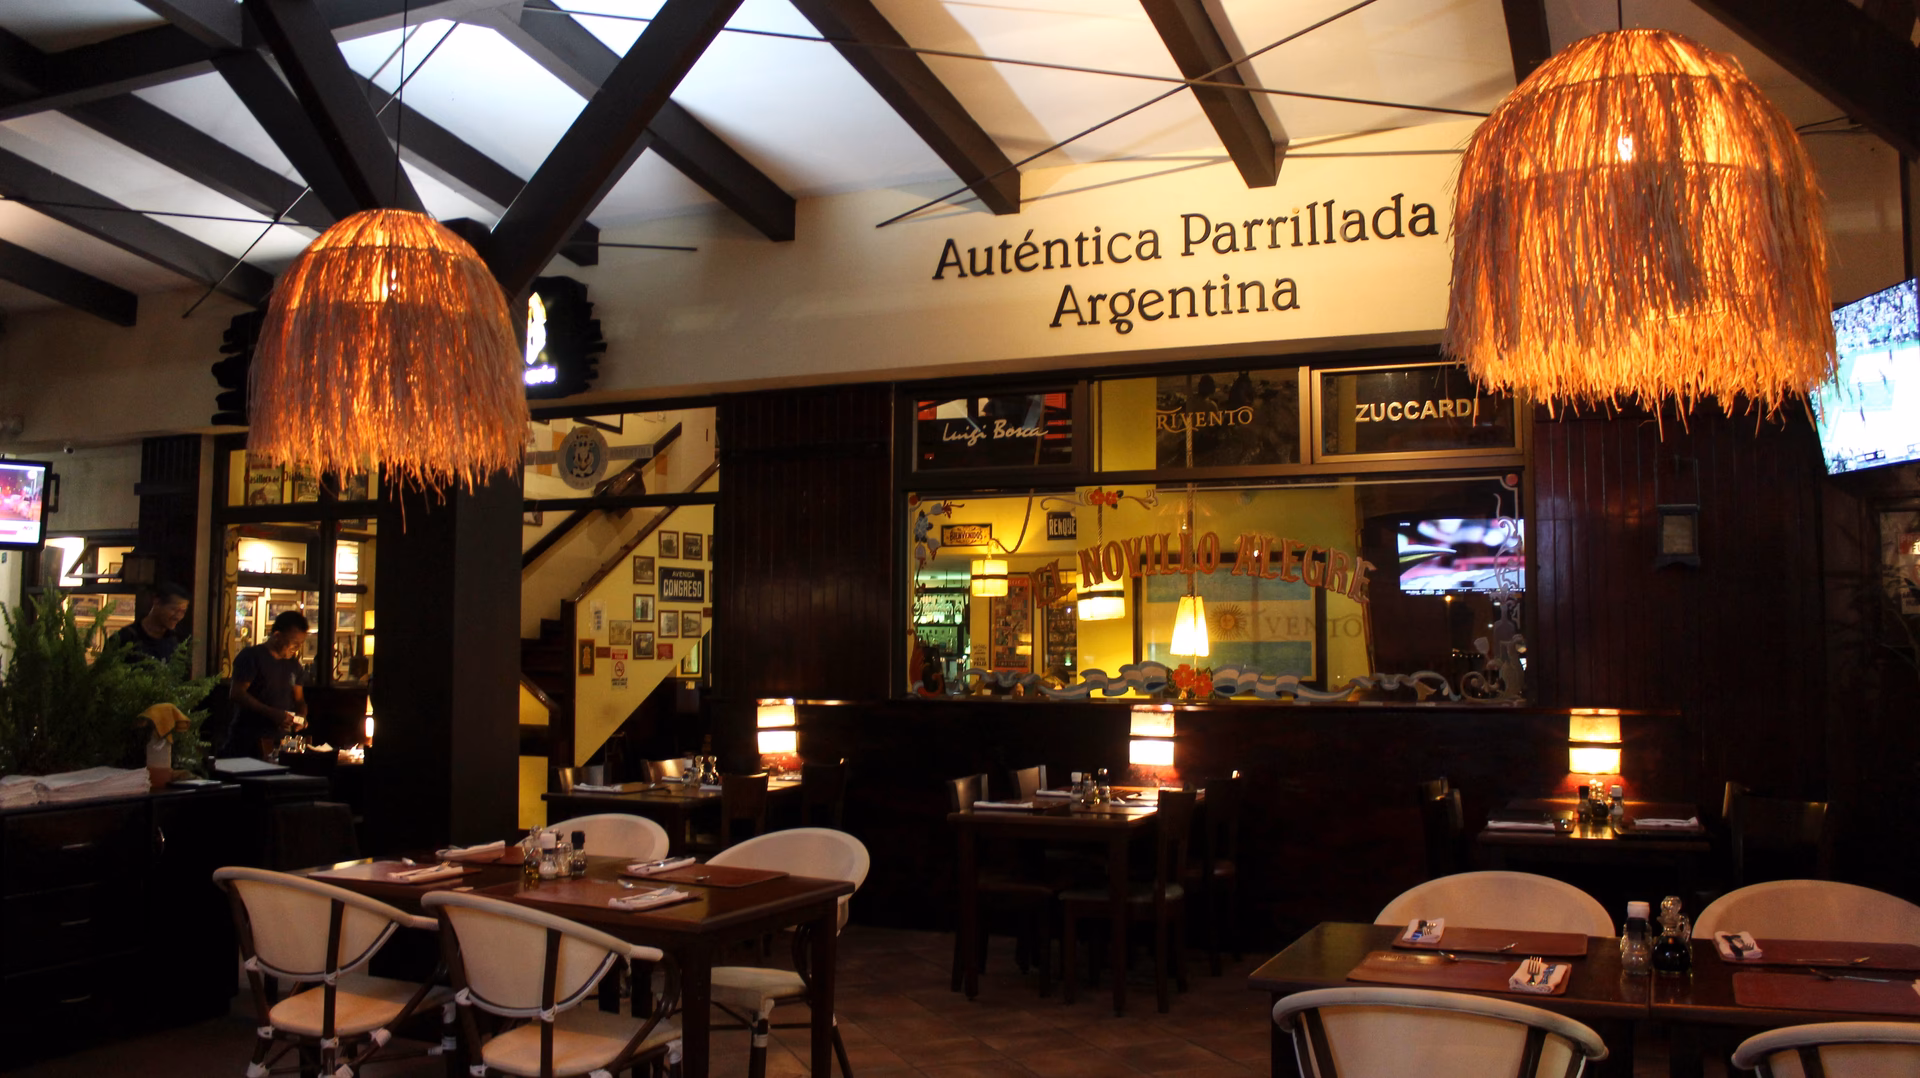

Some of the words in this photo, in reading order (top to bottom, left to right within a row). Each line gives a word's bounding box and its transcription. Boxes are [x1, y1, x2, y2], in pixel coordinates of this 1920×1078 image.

[932, 225, 1162, 281] Auténtica
[1180, 193, 1438, 257] Parrillada
[1049, 273, 1300, 334] Argentina
[1156, 406, 1255, 433] RIVENTO
[1355, 398, 1480, 423] ZUCCARDI
[942, 422, 987, 447] Luigi
[993, 418, 1049, 440] Bosca
[1028, 558, 1074, 609] EL
[1078, 531, 1221, 588] NOVILLO
[1232, 532, 1377, 605] ALEGRE
[663, 579, 702, 598] CONGRESO
